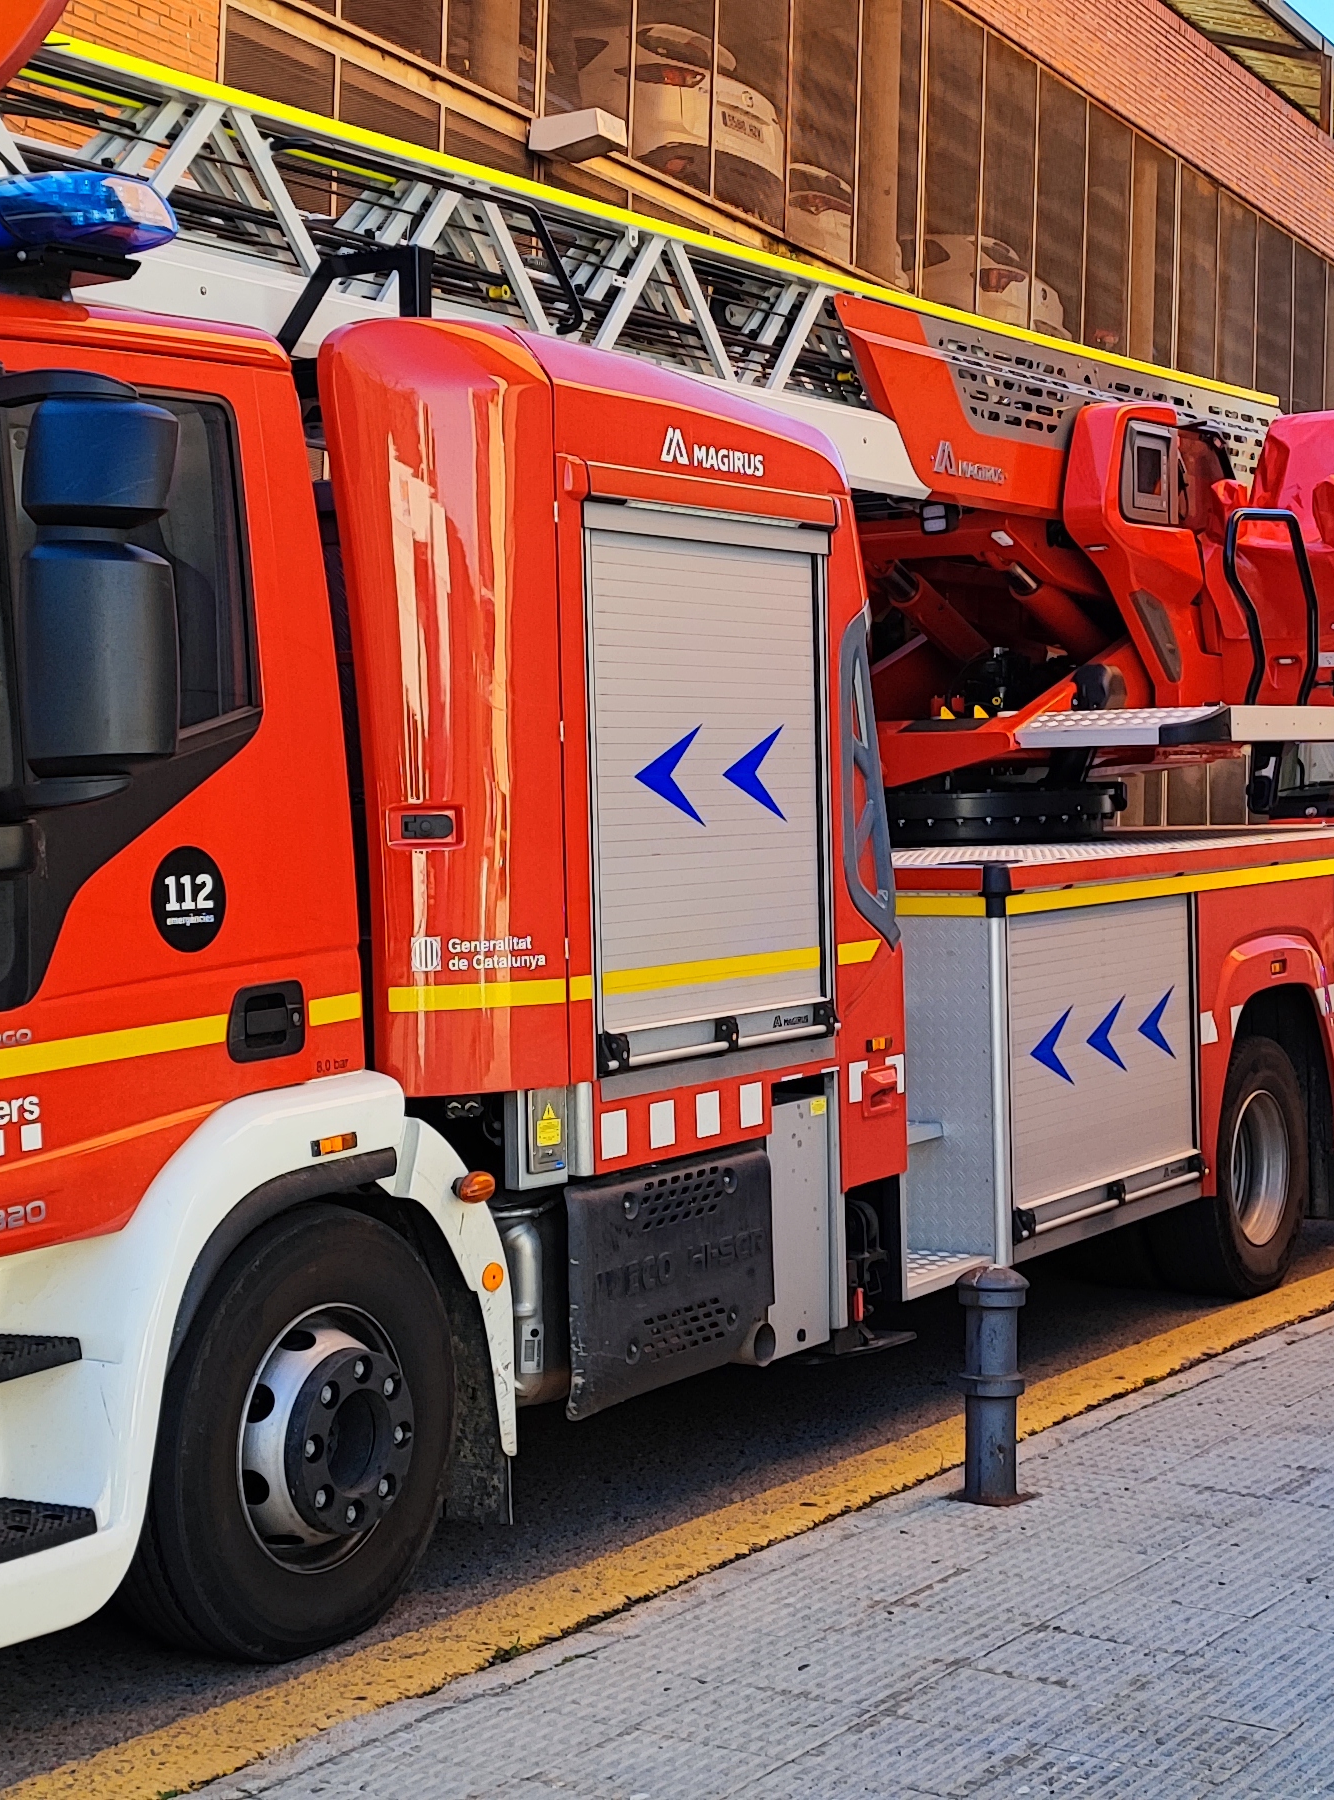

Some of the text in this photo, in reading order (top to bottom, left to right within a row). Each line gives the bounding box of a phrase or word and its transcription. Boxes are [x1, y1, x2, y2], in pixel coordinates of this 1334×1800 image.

[693, 443, 764, 477] MAGIRUS
[958, 460, 1005, 485] MAGIRUS
[164, 873, 214, 911] 112
[448, 935, 532, 954] Generalitat
[448, 953, 547, 971] de Catalunya
[333, 1058, 349, 1070] bar
